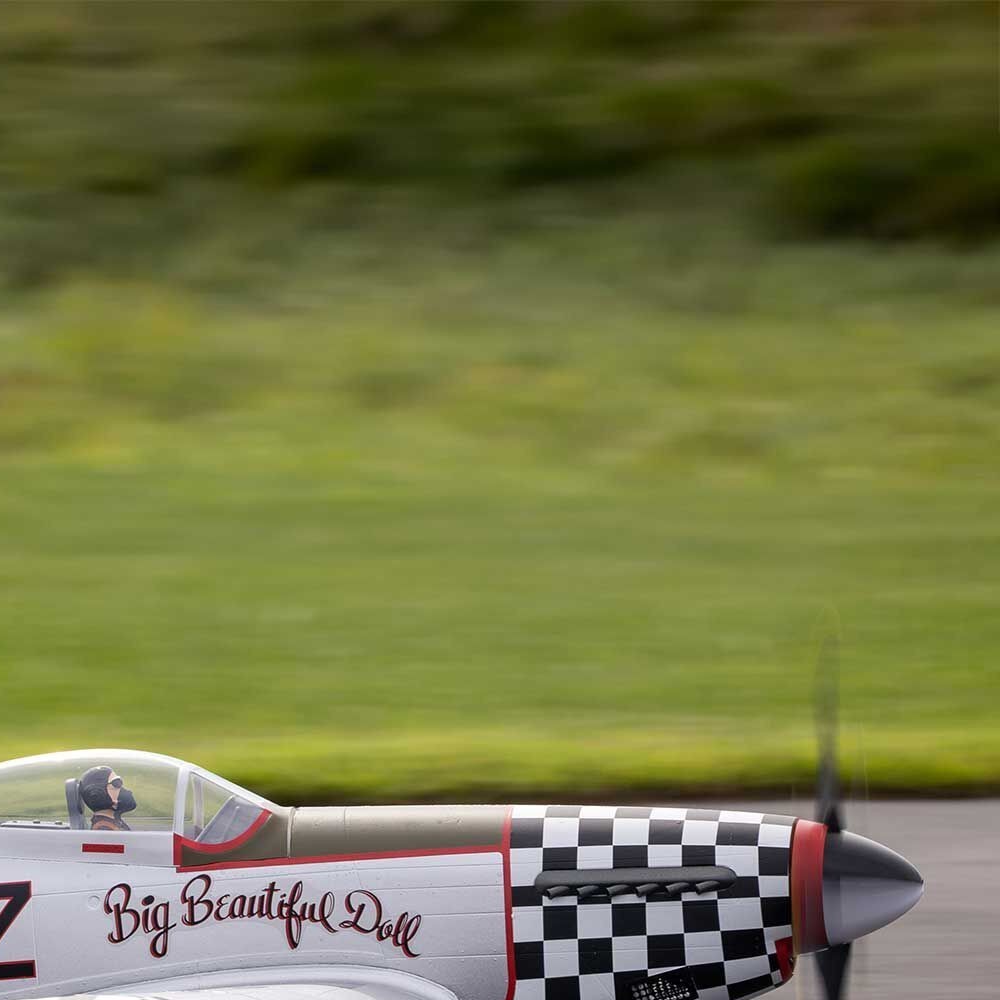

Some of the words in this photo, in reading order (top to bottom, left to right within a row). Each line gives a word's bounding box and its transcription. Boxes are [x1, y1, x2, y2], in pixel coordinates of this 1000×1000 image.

[103, 882, 177, 959] Big
[181, 873, 337, 950] Beautiful
[338, 889, 422, 959] Doll
